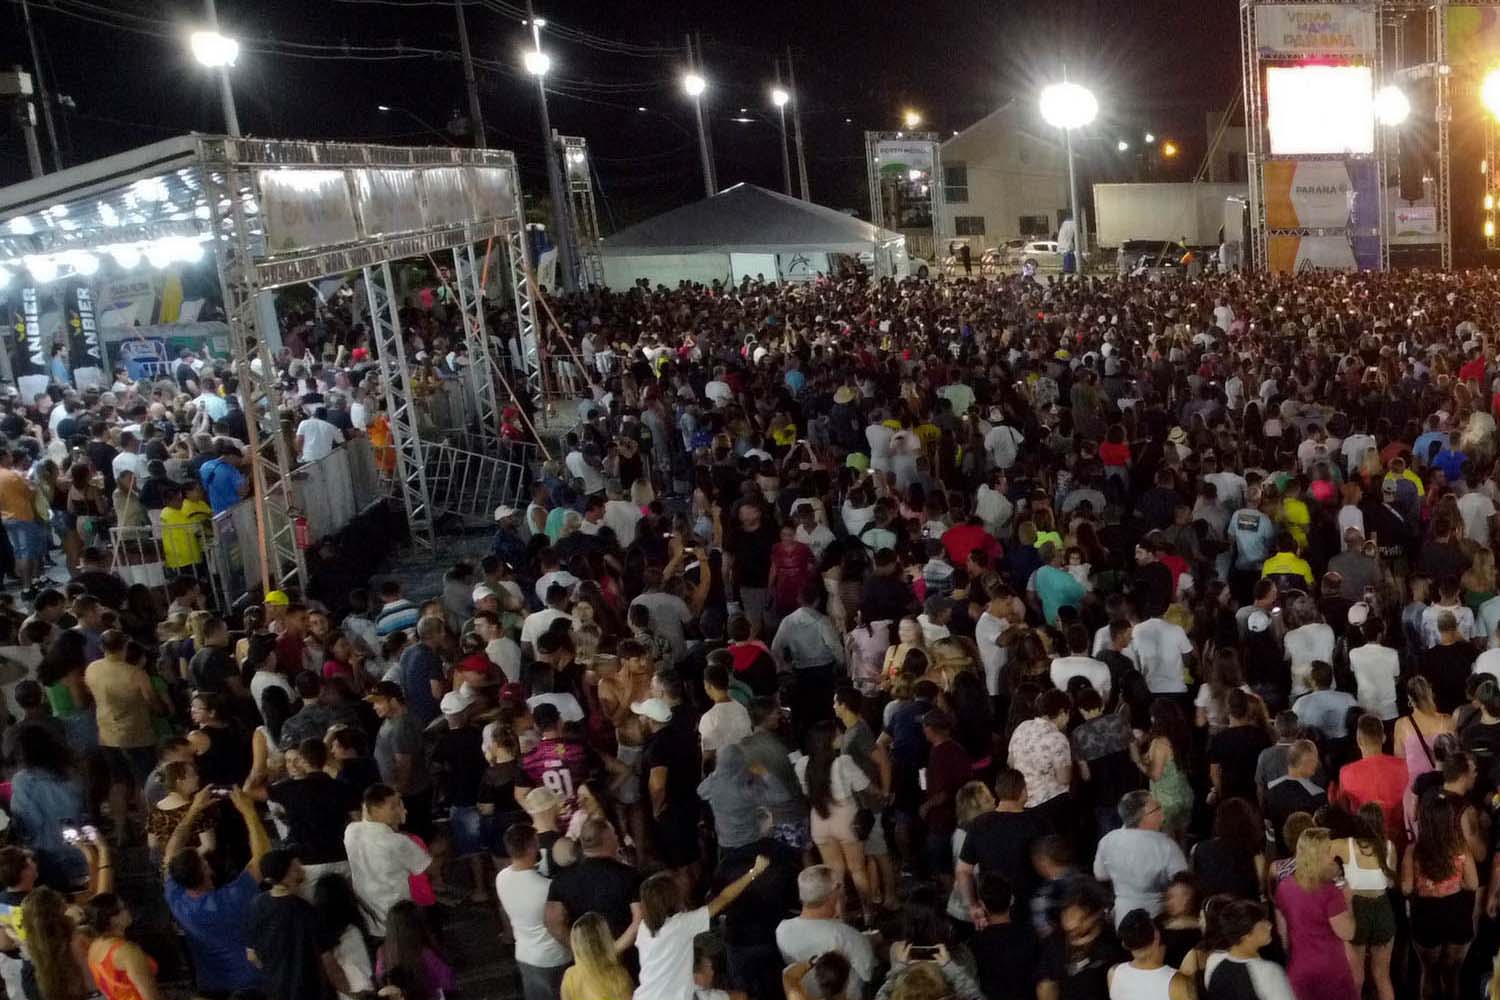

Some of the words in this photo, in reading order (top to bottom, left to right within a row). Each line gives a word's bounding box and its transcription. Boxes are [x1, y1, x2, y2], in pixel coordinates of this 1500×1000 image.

[23, 287, 46, 366] ANBIER
[77, 287, 100, 360] ANBIER
[542, 768, 574, 799] 91
